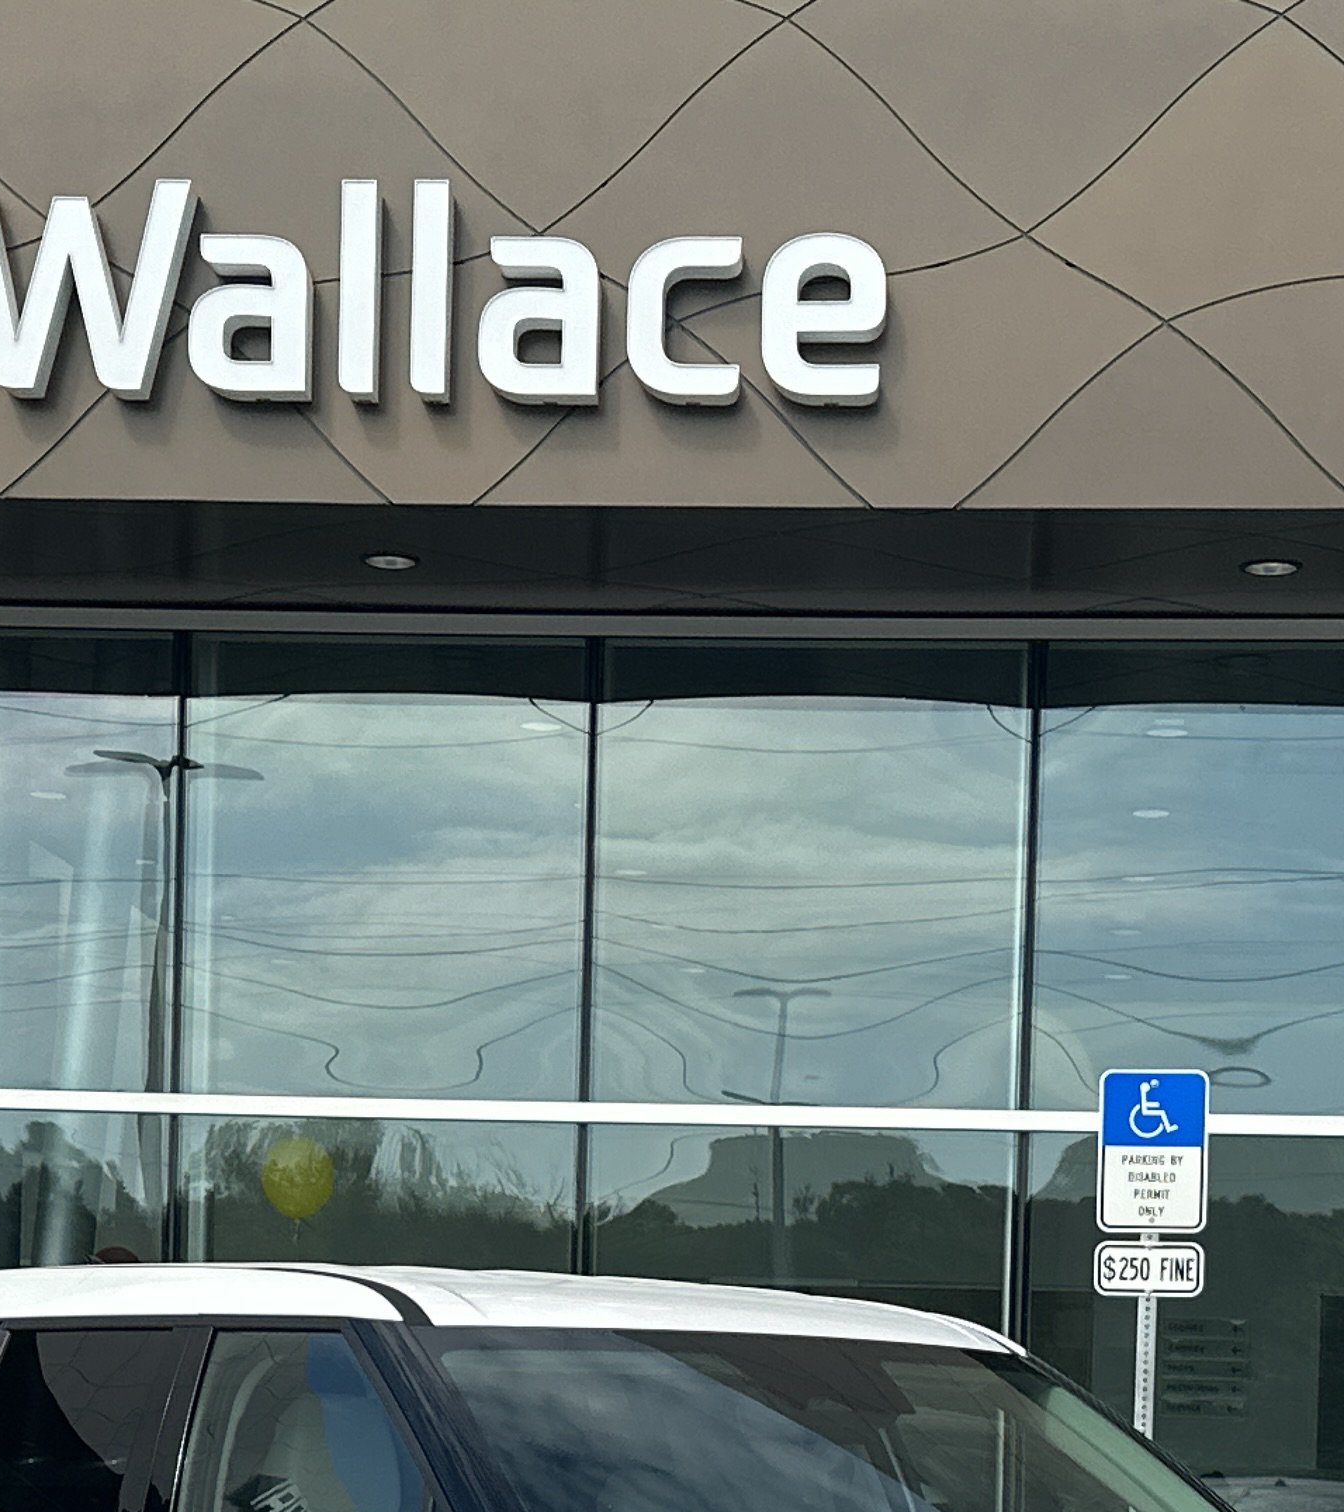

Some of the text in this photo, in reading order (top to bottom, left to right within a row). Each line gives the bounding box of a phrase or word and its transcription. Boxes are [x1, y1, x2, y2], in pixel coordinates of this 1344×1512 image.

[1121, 1155, 1184, 1166] PARKING BY
[1133, 1189, 1170, 1200] PERMIT
[1138, 1206, 1165, 1217] ONLY
[1103, 1255, 1195, 1282] $250 FINE
